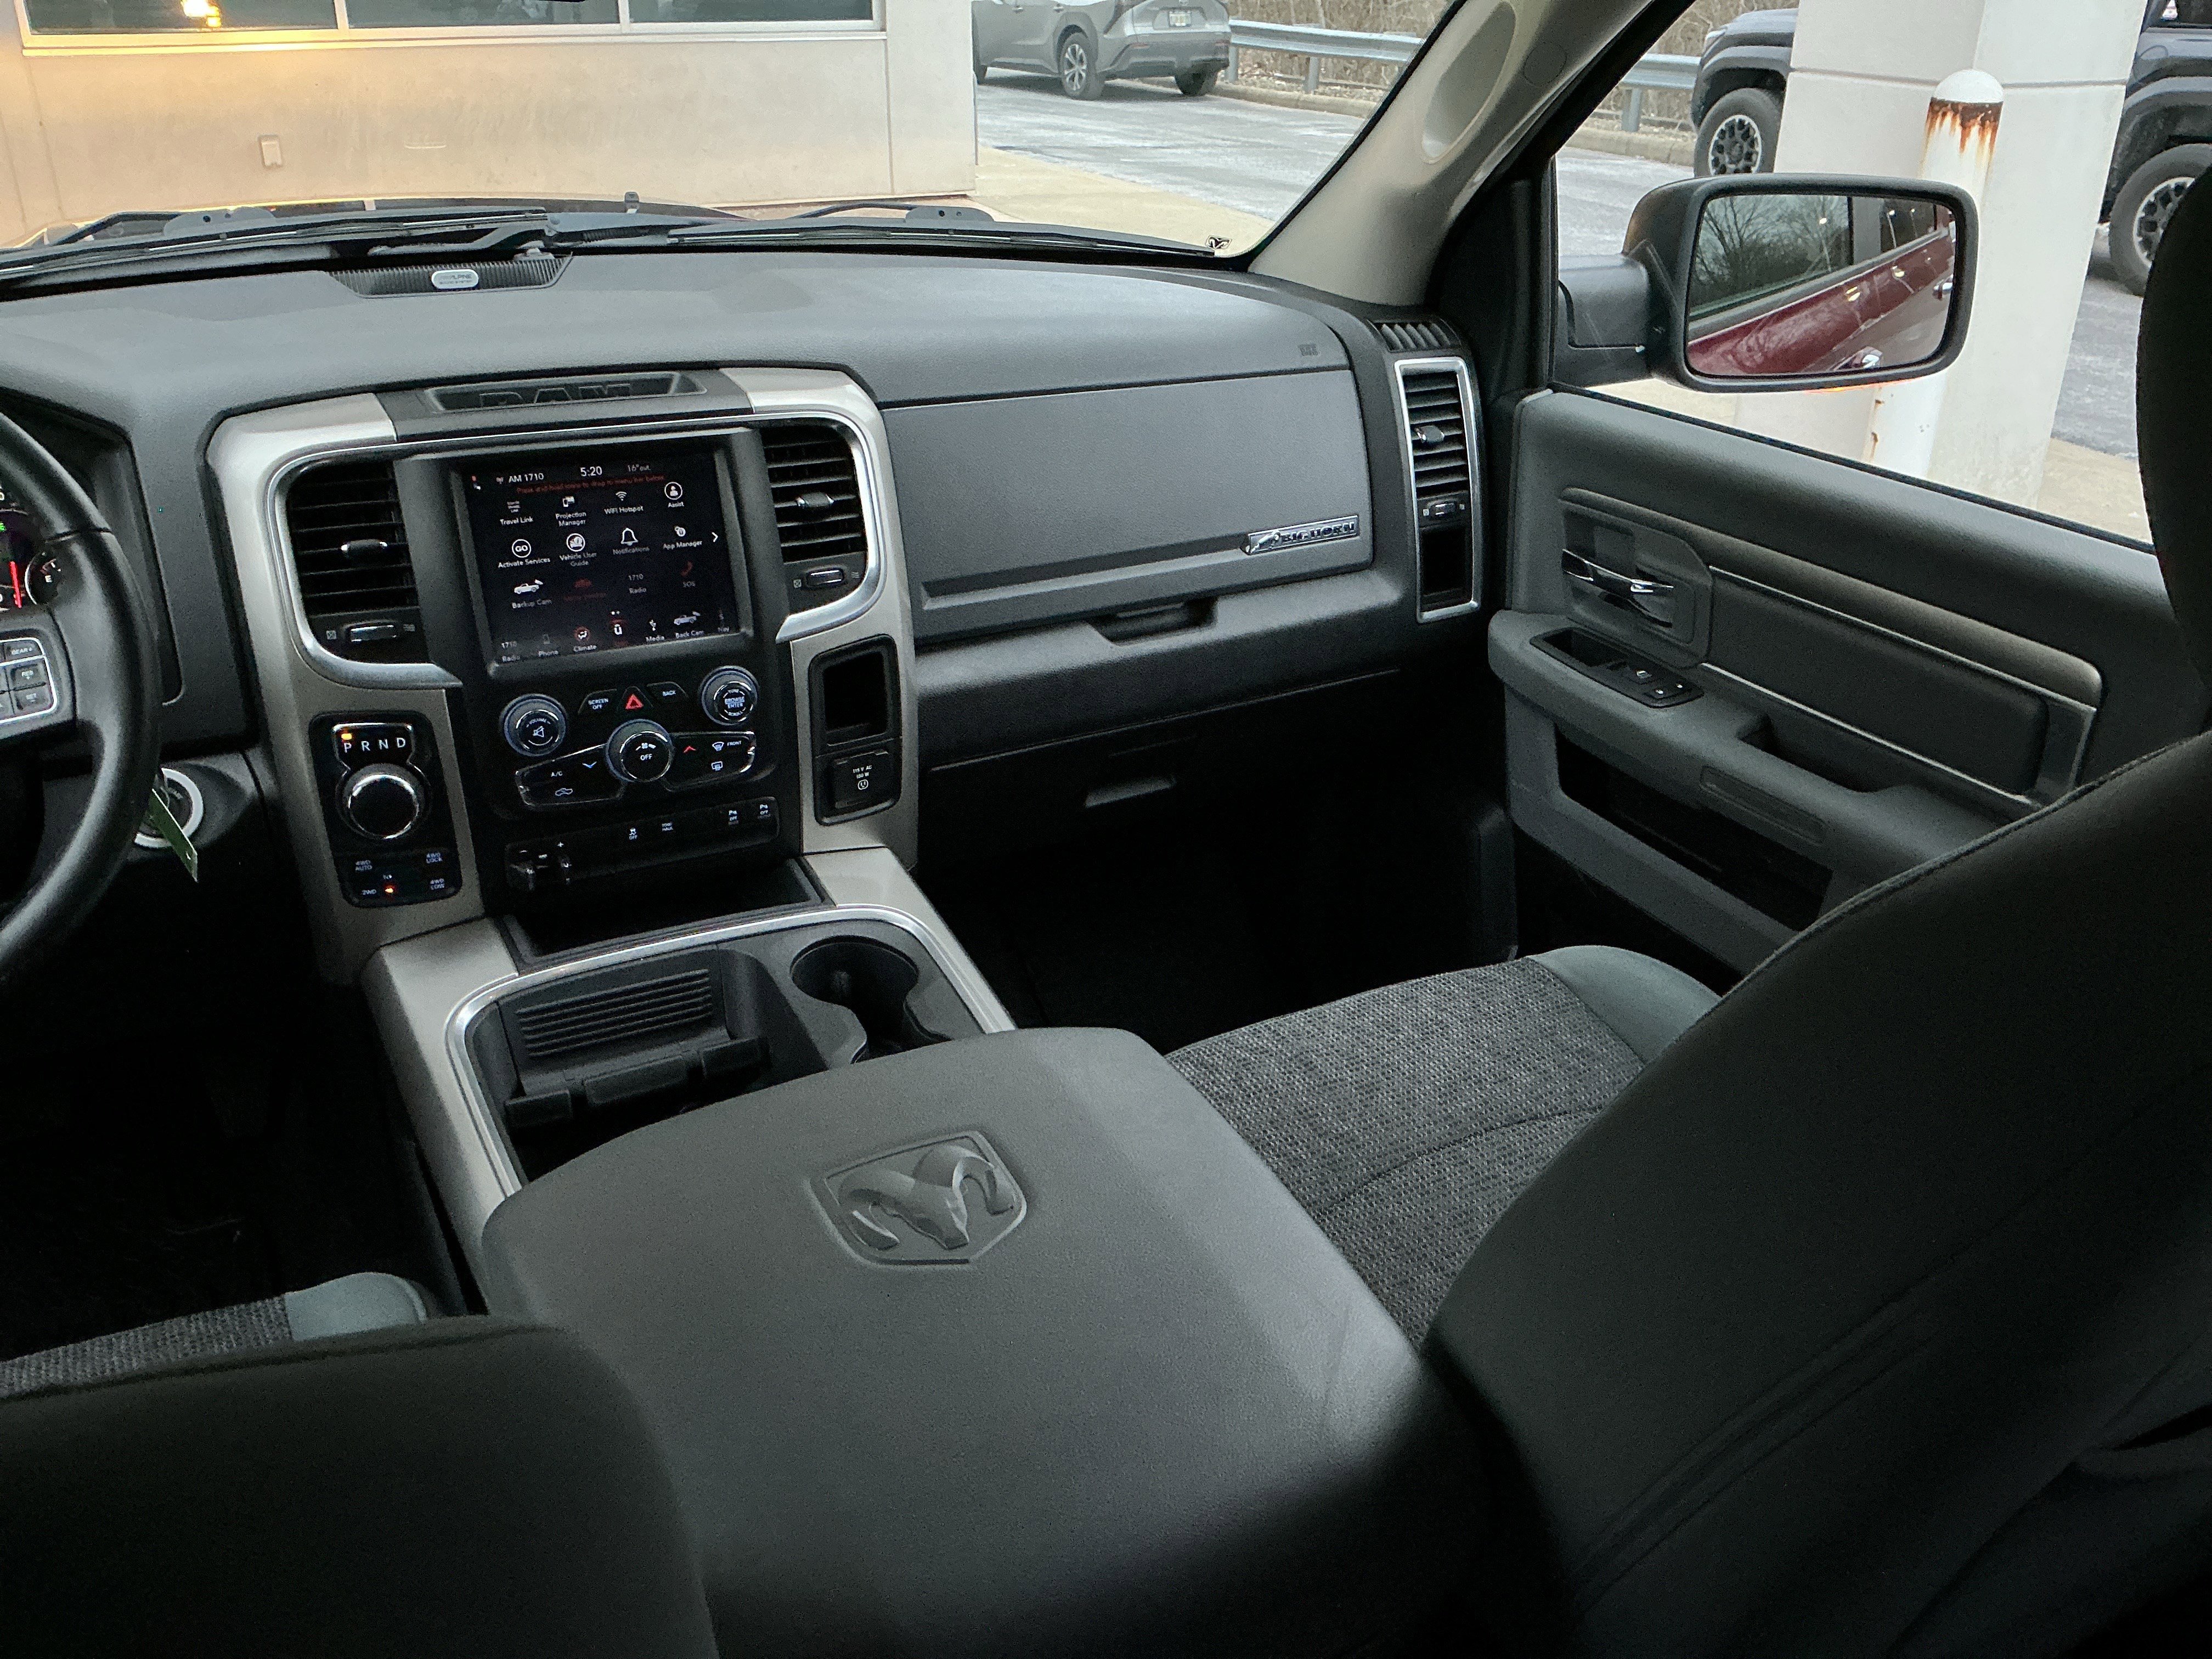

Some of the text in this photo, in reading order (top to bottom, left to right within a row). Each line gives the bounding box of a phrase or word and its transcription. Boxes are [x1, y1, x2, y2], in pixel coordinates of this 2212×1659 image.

[580, 466, 602, 476] 5:20
[524, 473, 544, 481] 1710
[555, 512, 586, 520] Projection
[500, 517, 519, 526] Travel
[1281, 522, 1355, 543] BIG HORN
[613, 546, 650, 555] Notifications
[498, 557, 550, 568] Activate Services
[344, 737, 406, 753] P R N D
